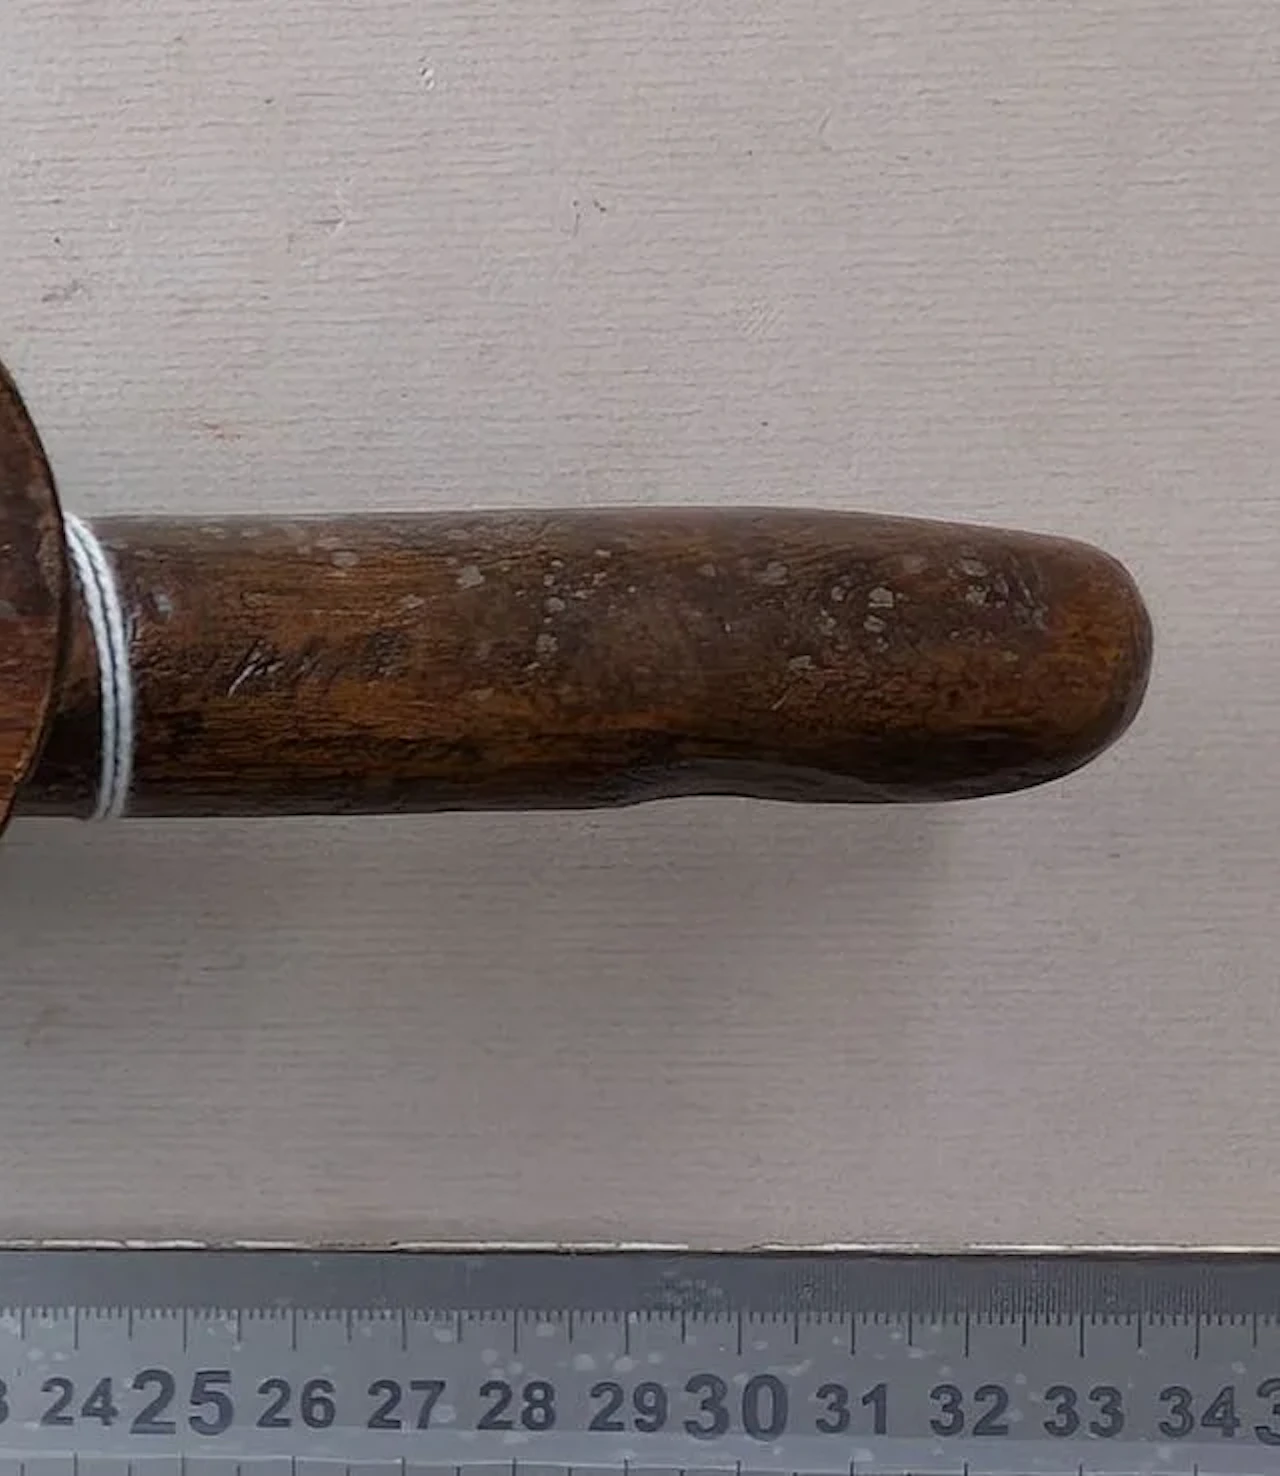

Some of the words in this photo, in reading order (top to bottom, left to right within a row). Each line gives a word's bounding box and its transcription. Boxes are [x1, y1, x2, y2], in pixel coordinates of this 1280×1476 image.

[40, 1376, 119, 1427] 24
[129, 1369, 234, 1436] 25
[256, 1378, 337, 1429] 26
[367, 1379, 447, 1430] 27
[475, 1380, 557, 1432] 28
[587, 1381, 668, 1433] 29
[683, 1373, 789, 1438] 30
[815, 1383, 888, 1435] 31
[929, 1383, 1009, 1437] 32
[1043, 1385, 1125, 1438] 33
[1158, 1385, 1241, 1438] 34
